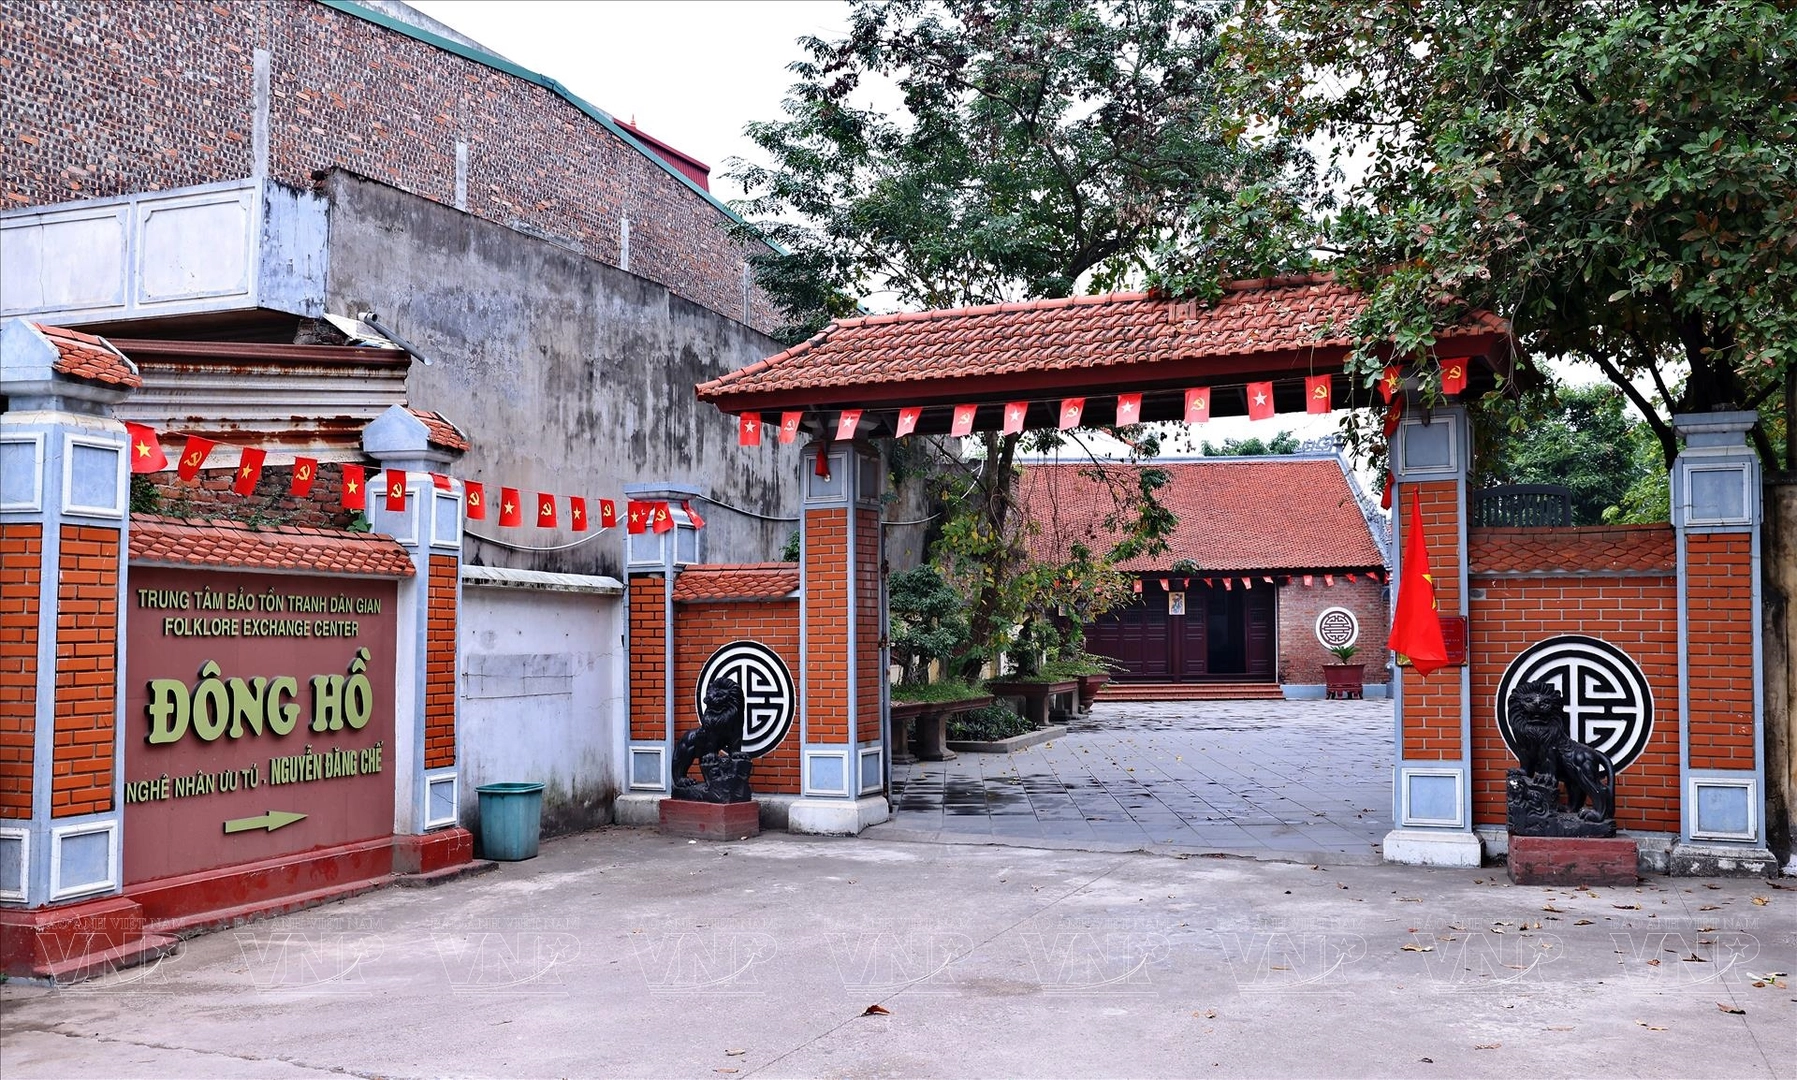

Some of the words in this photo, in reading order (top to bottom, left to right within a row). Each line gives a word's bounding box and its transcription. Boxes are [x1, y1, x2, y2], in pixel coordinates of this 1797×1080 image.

[137, 588, 190, 610] TRUNG
[194, 585, 223, 610] TÂM
[227, 586, 256, 611] BẢO
[258, 586, 284, 612] TỒN
[287, 595, 327, 613] TRANH
[329, 592, 353, 613] DÂN
[355, 597, 381, 614] GIAN
[164, 617, 239, 636] FOLKLORE
[243, 618, 311, 636] EXCHANGE
[314, 620, 359, 637] CENTER
[148, 659, 301, 744] ĐÔNG
[311, 646, 373, 732] HỒ
[175, 769, 215, 798] NHÂN
[270, 744, 322, 785] NGUYỄN
[324, 747, 358, 779] ĐĂNG
[360, 740, 384, 774] CHẾ
